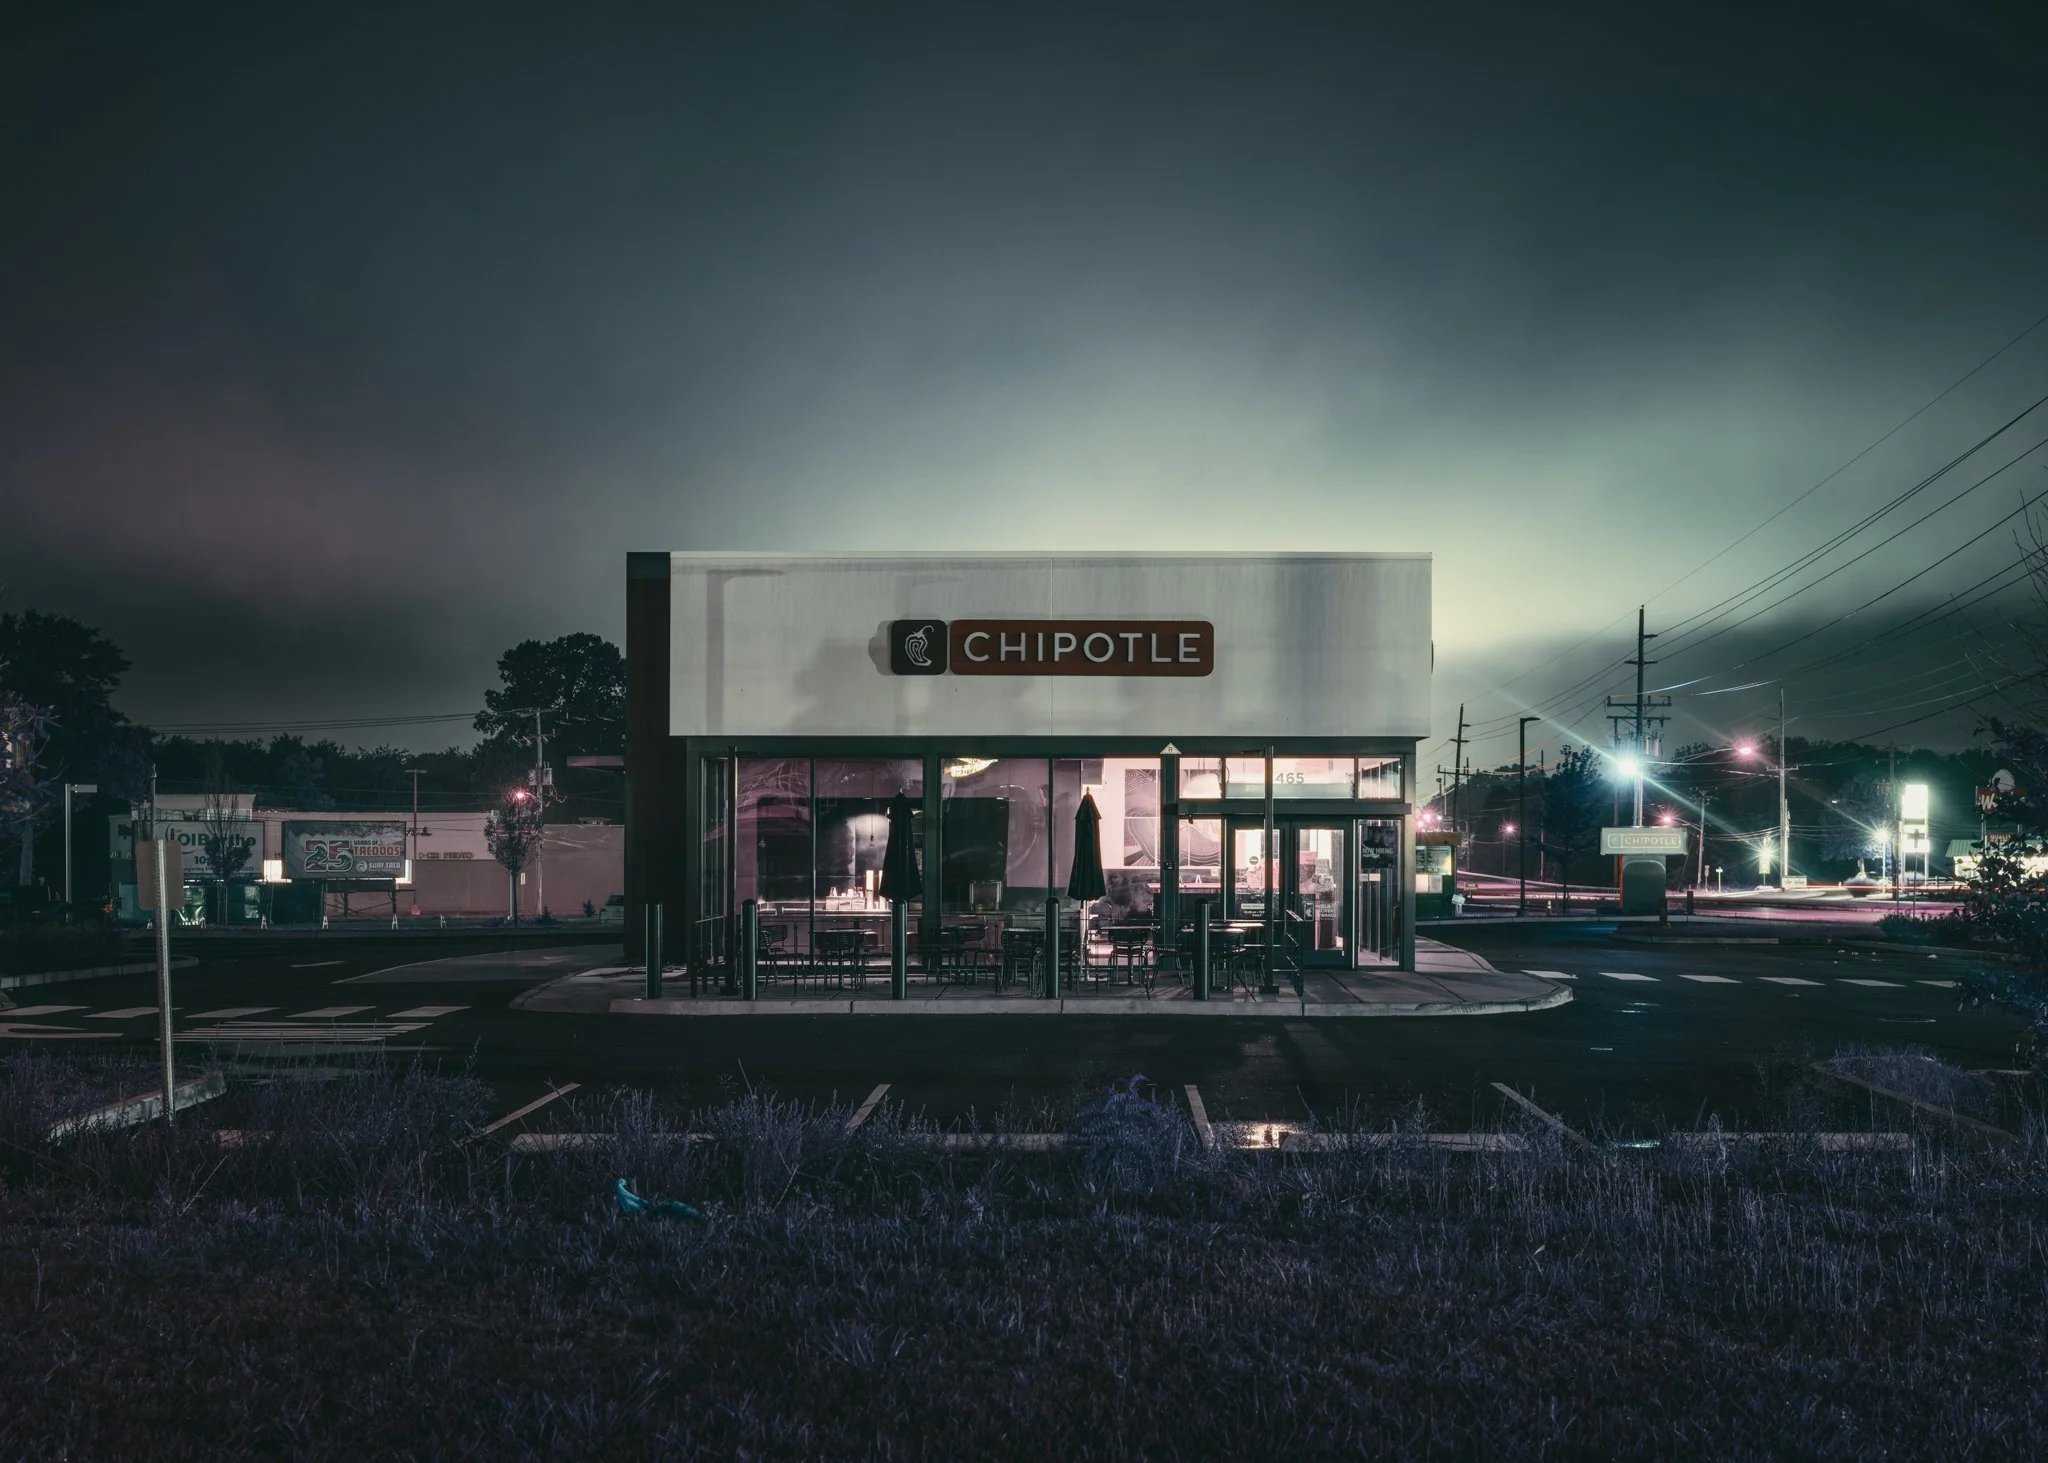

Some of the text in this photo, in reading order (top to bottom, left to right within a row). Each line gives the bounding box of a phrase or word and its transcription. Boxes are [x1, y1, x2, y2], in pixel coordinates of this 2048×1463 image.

[963, 631, 1201, 663] CHIPOTLE
[1275, 772, 1304, 784] 465
[1624, 837, 1677, 845] CHIPOTLE
[304, 839, 354, 873] 25
[1375, 847, 1394, 855] HIRING
